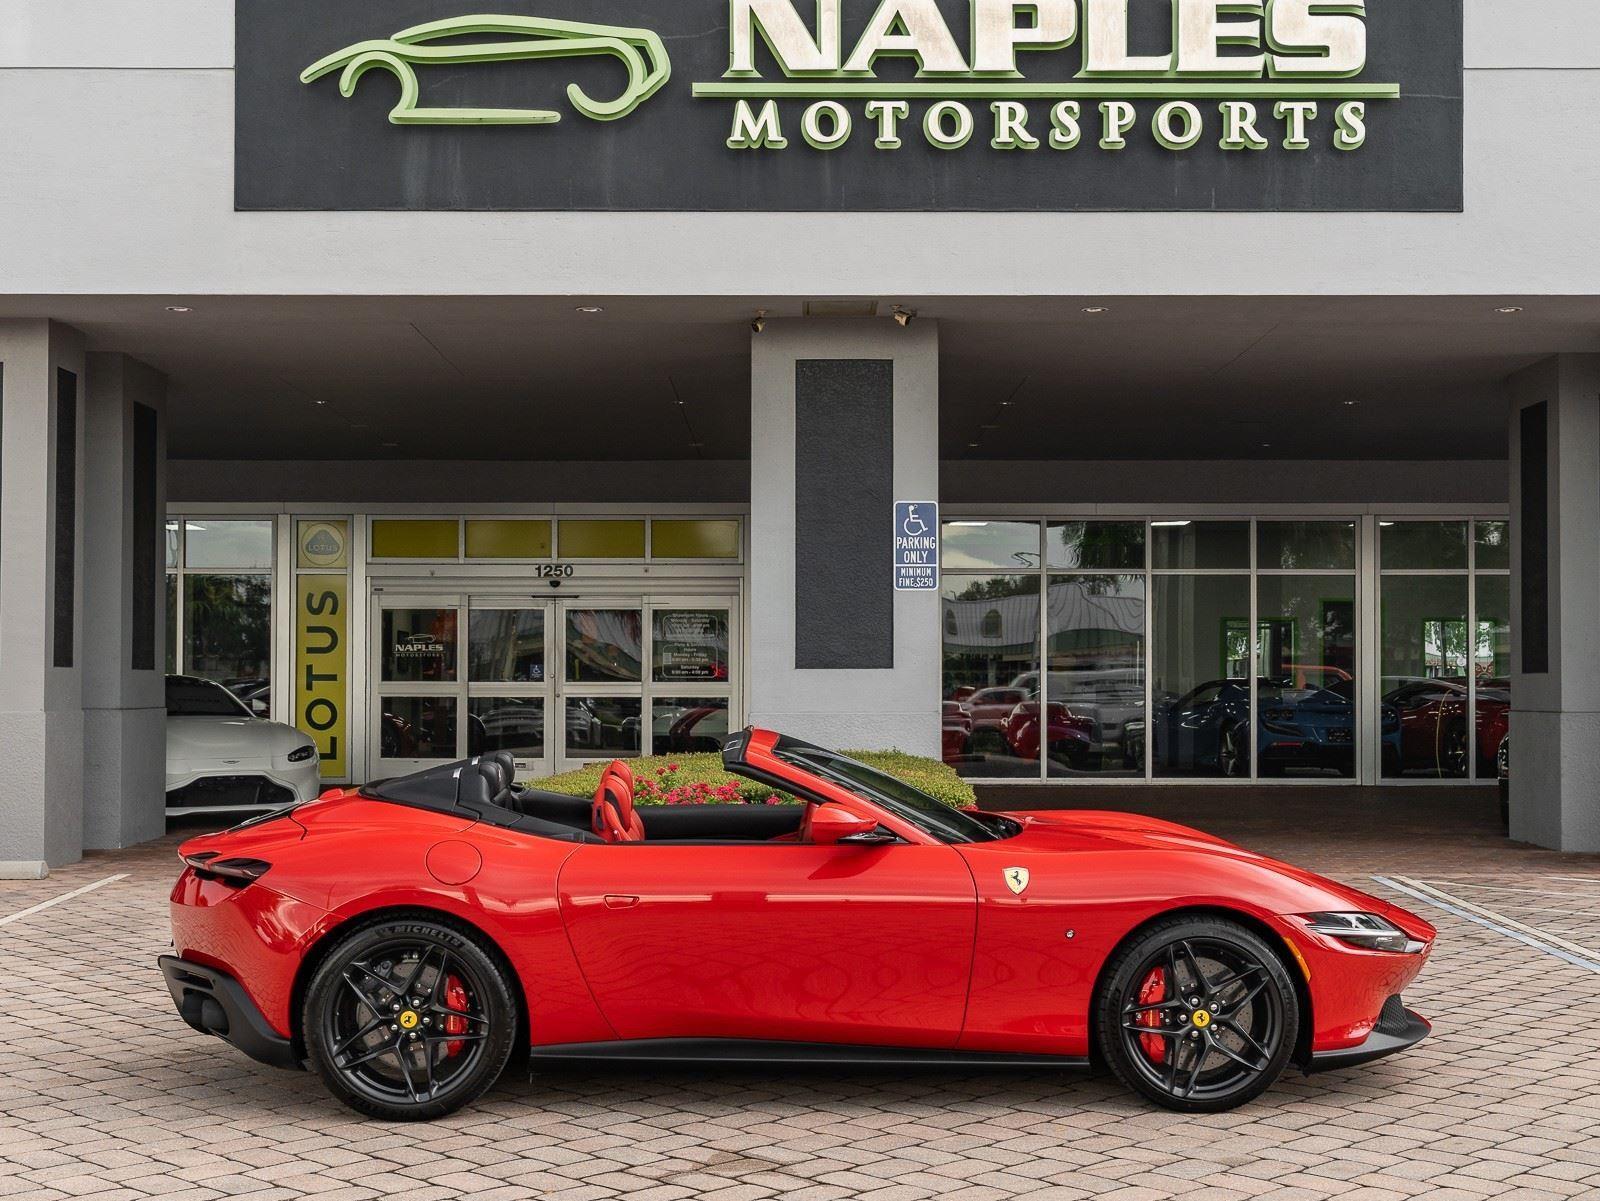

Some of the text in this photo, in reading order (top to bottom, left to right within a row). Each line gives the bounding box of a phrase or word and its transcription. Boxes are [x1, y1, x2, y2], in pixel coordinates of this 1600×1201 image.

[721, 0, 1368, 79] NAPLES
[727, 100, 1366, 151] MOTORSPORTS
[896, 537, 935, 549] PARKING
[904, 551, 928, 563] ONLY
[535, 564, 574, 578] 1250
[901, 568, 931, 577] MINIMUM
[395, 644, 444, 652] NAPLES
[306, 591, 339, 760] LOTUS
[394, 926, 461, 946] MICHELIN
